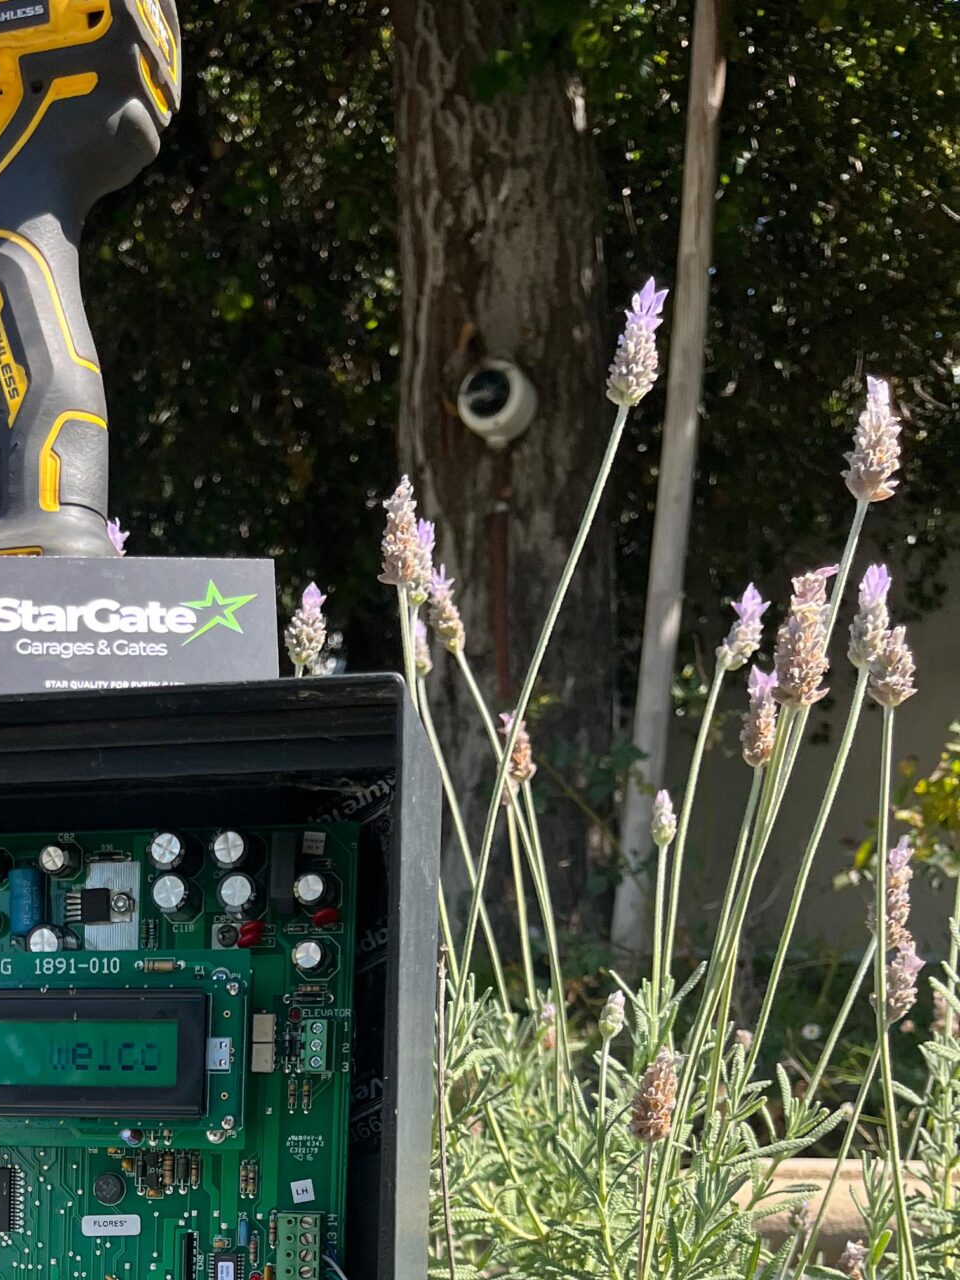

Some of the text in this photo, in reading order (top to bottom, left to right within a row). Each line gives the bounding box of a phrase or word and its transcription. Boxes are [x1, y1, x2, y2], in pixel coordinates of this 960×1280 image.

[16, 638, 168, 658] Garages & Gates
[45, 680, 68, 688] STAR
[70, 680, 108, 689] QUALITY
[110, 680, 130, 689] FOR
[34, 957, 120, 975] 1891-010
[302, 1008, 352, 1018] ELEVATOR
[343, 1022, 349, 1032] 1
[342, 1043, 349, 1053] 2
[342, 1062, 349, 1072] 3
[295, 1187, 309, 1196] LH
[327, 1213, 338, 1227] 14
